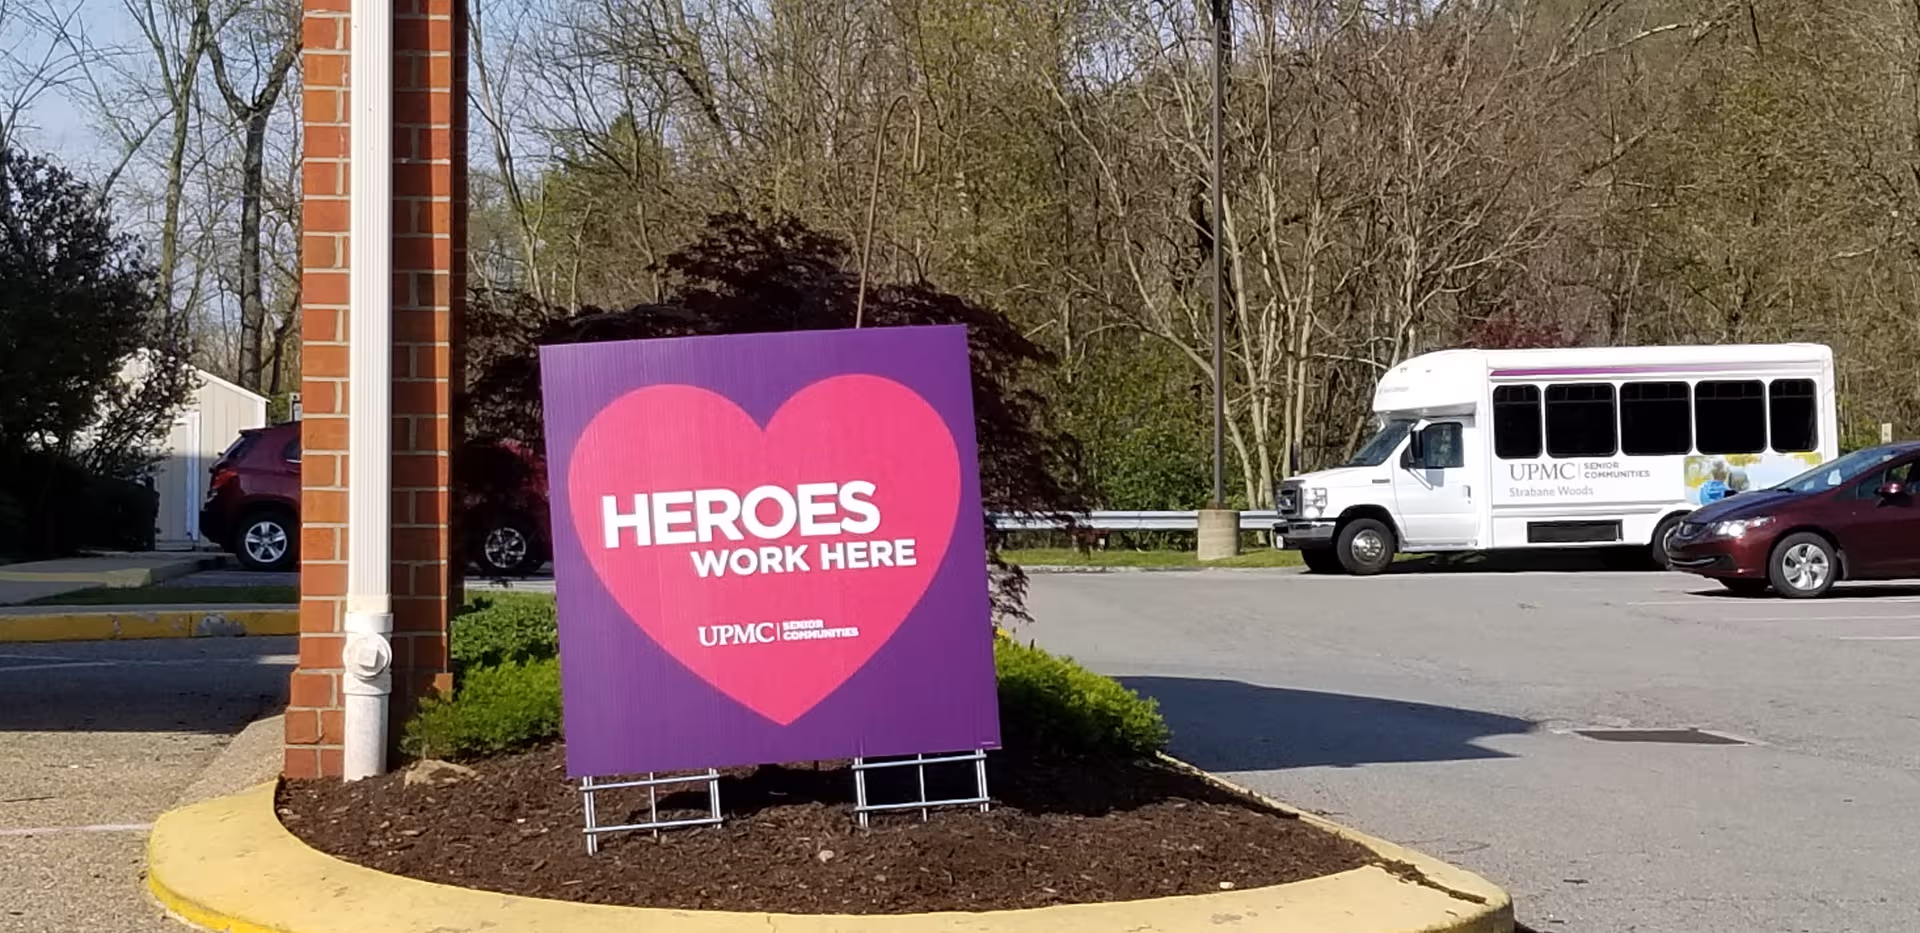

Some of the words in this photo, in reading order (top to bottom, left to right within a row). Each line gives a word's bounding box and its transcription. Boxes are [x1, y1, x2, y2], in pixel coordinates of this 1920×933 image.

[1508, 461, 1576, 481] UPMC
[1583, 461, 1620, 470] SENIOR
[1583, 470, 1650, 479] COMMUNITIES
[1508, 486, 1556, 497] Strabane
[1557, 485, 1594, 496] Woods
[601, 480, 881, 549] HEROES
[690, 544, 810, 578] WORK
[820, 538, 917, 571] HERE
[782, 619, 824, 631] SENIOR
[698, 622, 775, 647] UPMC
[782, 627, 860, 641] COMMUNITIES
